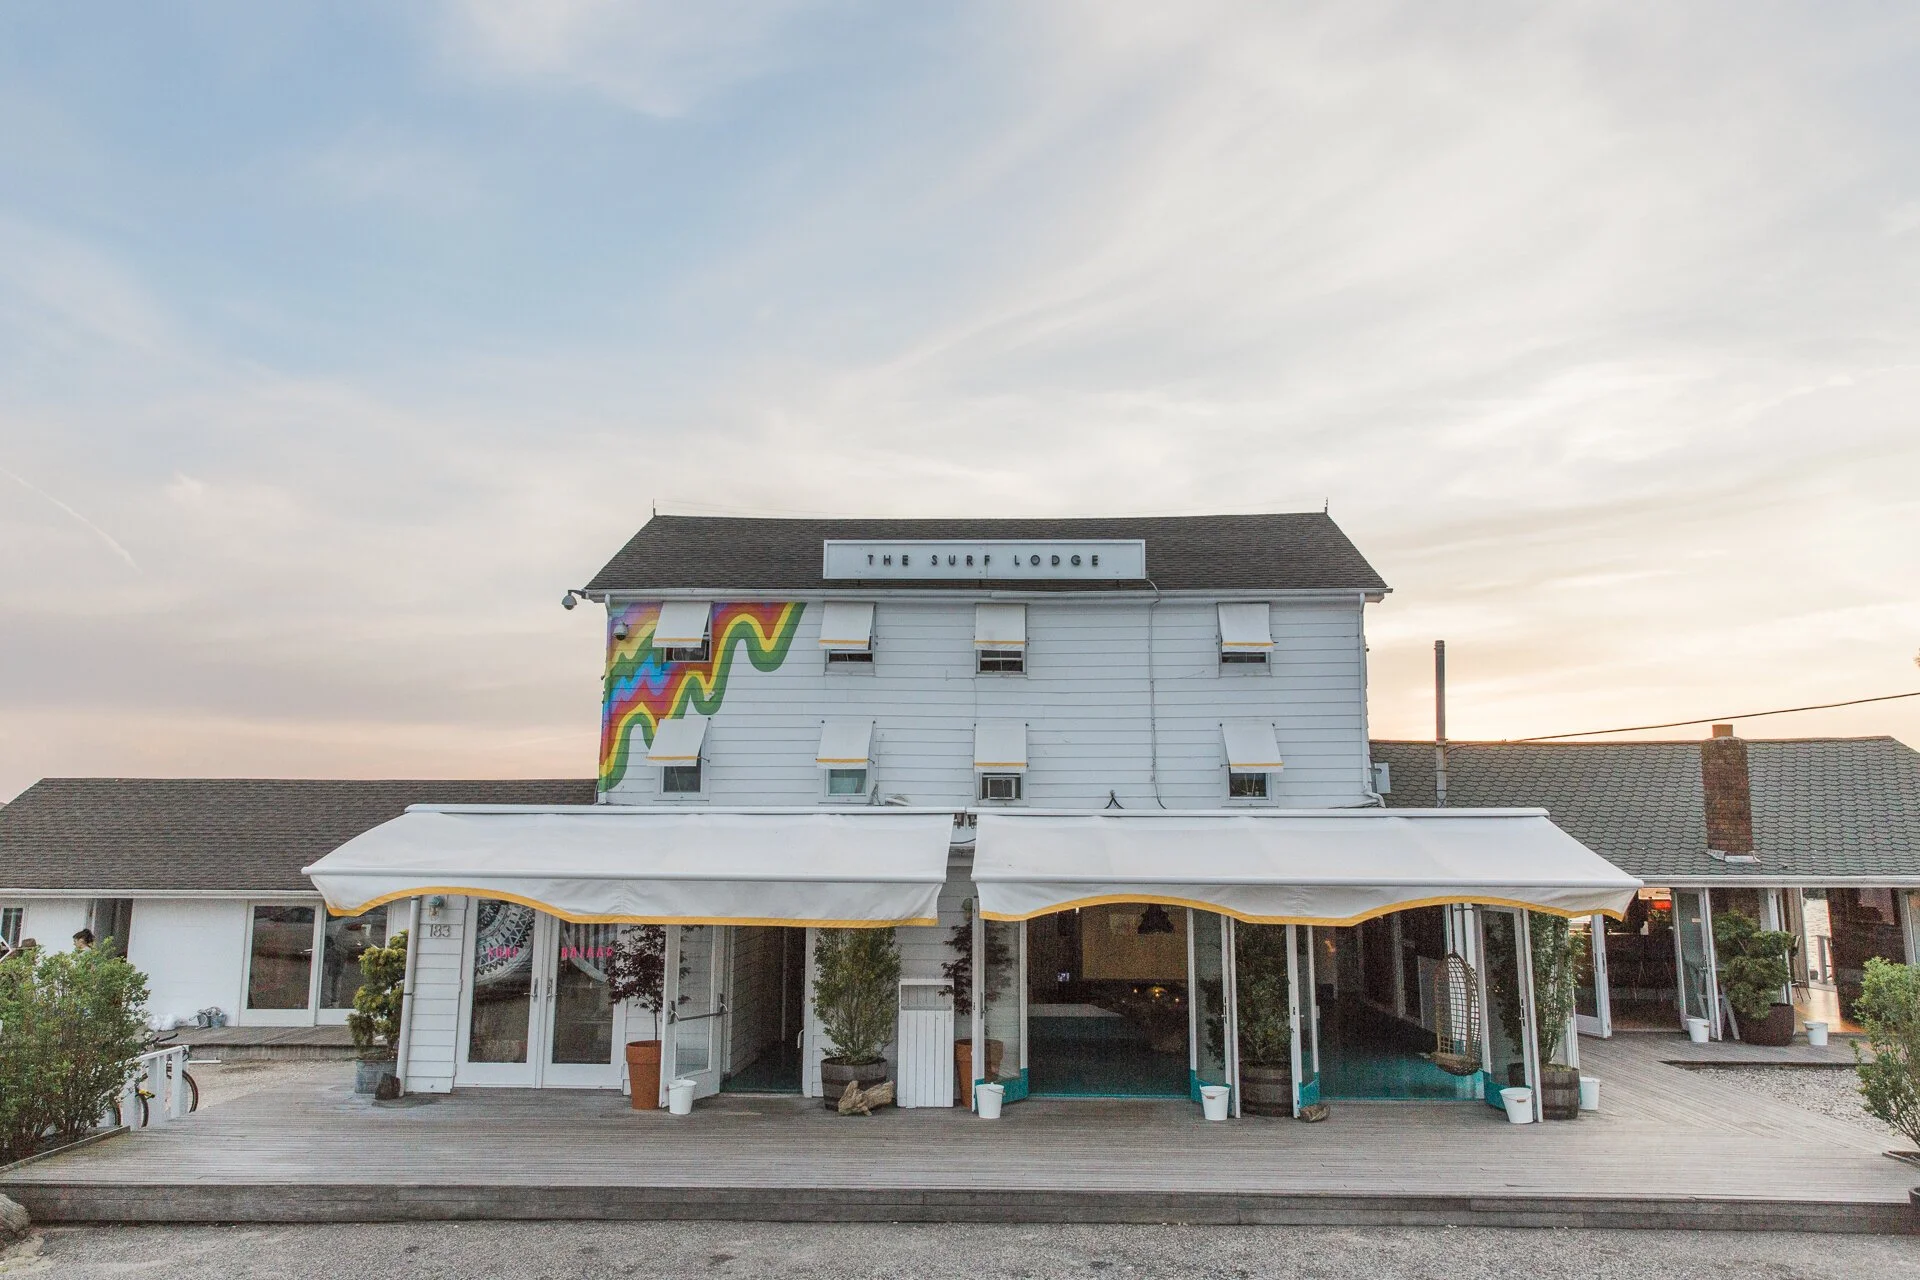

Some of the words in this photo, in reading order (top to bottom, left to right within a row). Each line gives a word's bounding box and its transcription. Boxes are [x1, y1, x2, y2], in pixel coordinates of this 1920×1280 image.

[867, 554, 909, 566] THE
[931, 554, 990, 566] SURF
[1014, 554, 1099, 566] LODGE
[430, 924, 450, 938] 183
[561, 946, 614, 960] BAZAAR
